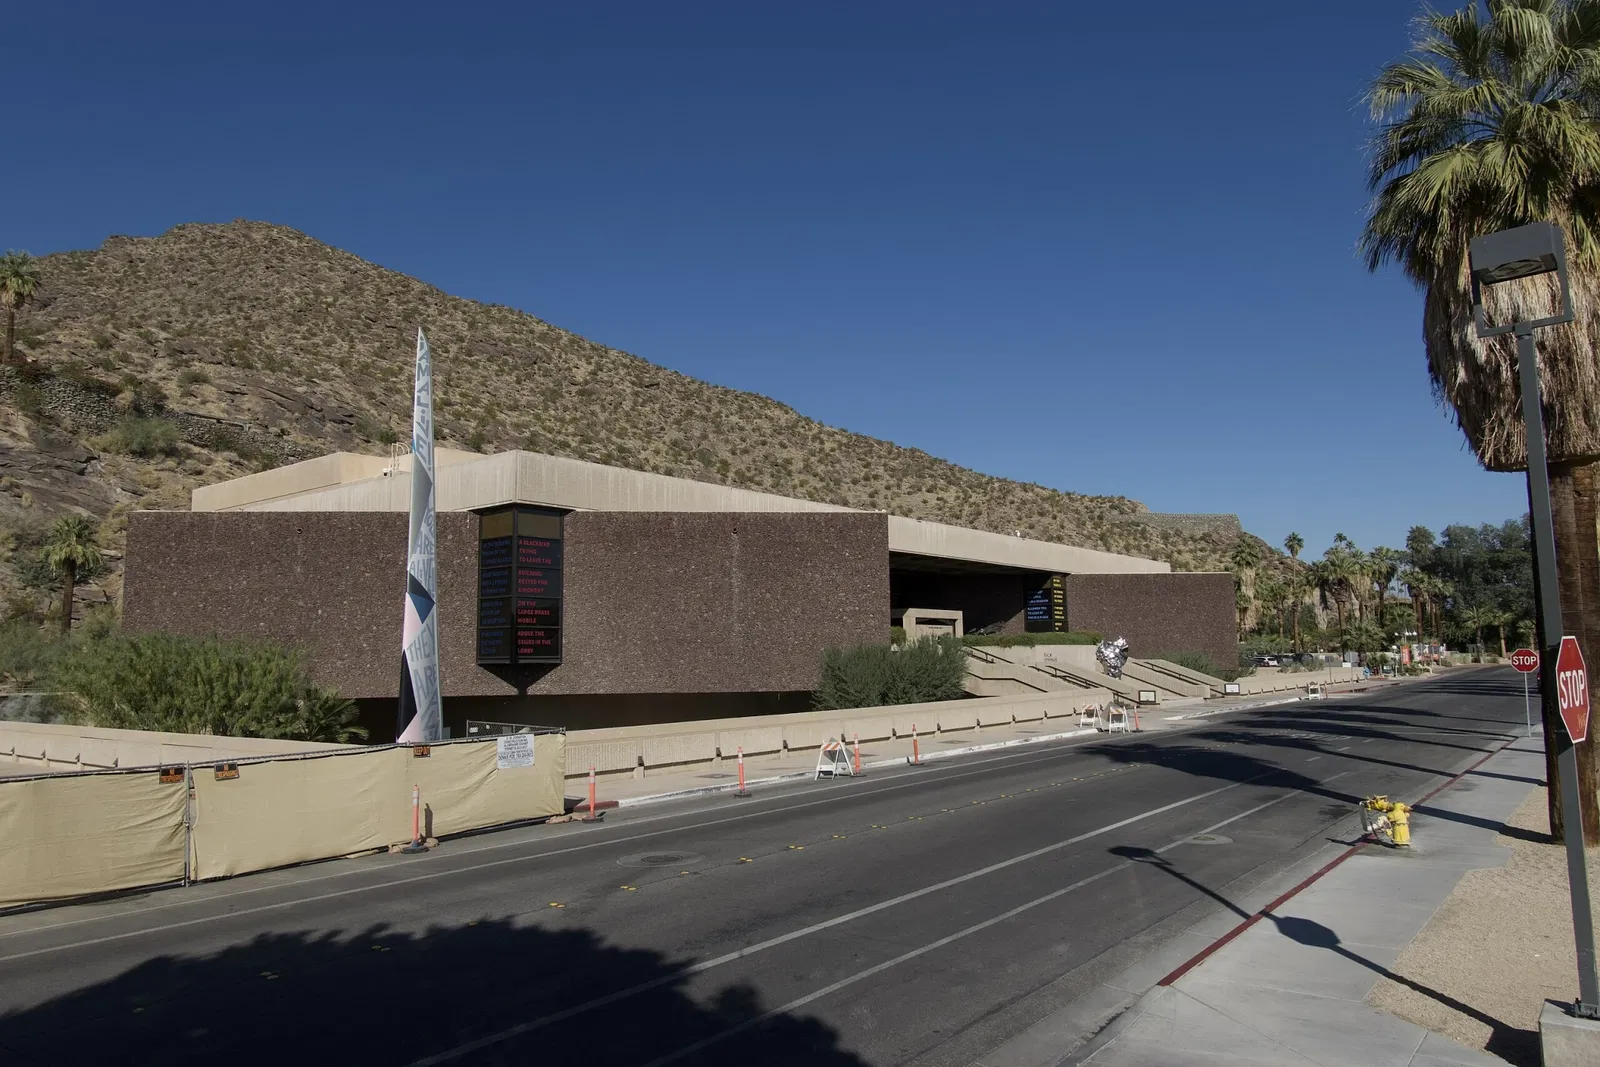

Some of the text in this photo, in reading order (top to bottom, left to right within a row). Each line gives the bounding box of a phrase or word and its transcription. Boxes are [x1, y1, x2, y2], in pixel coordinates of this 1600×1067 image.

[407, 612, 435, 661] THEY
[1512, 656, 1536, 666] STOP
[1560, 670, 1584, 709] STOP
